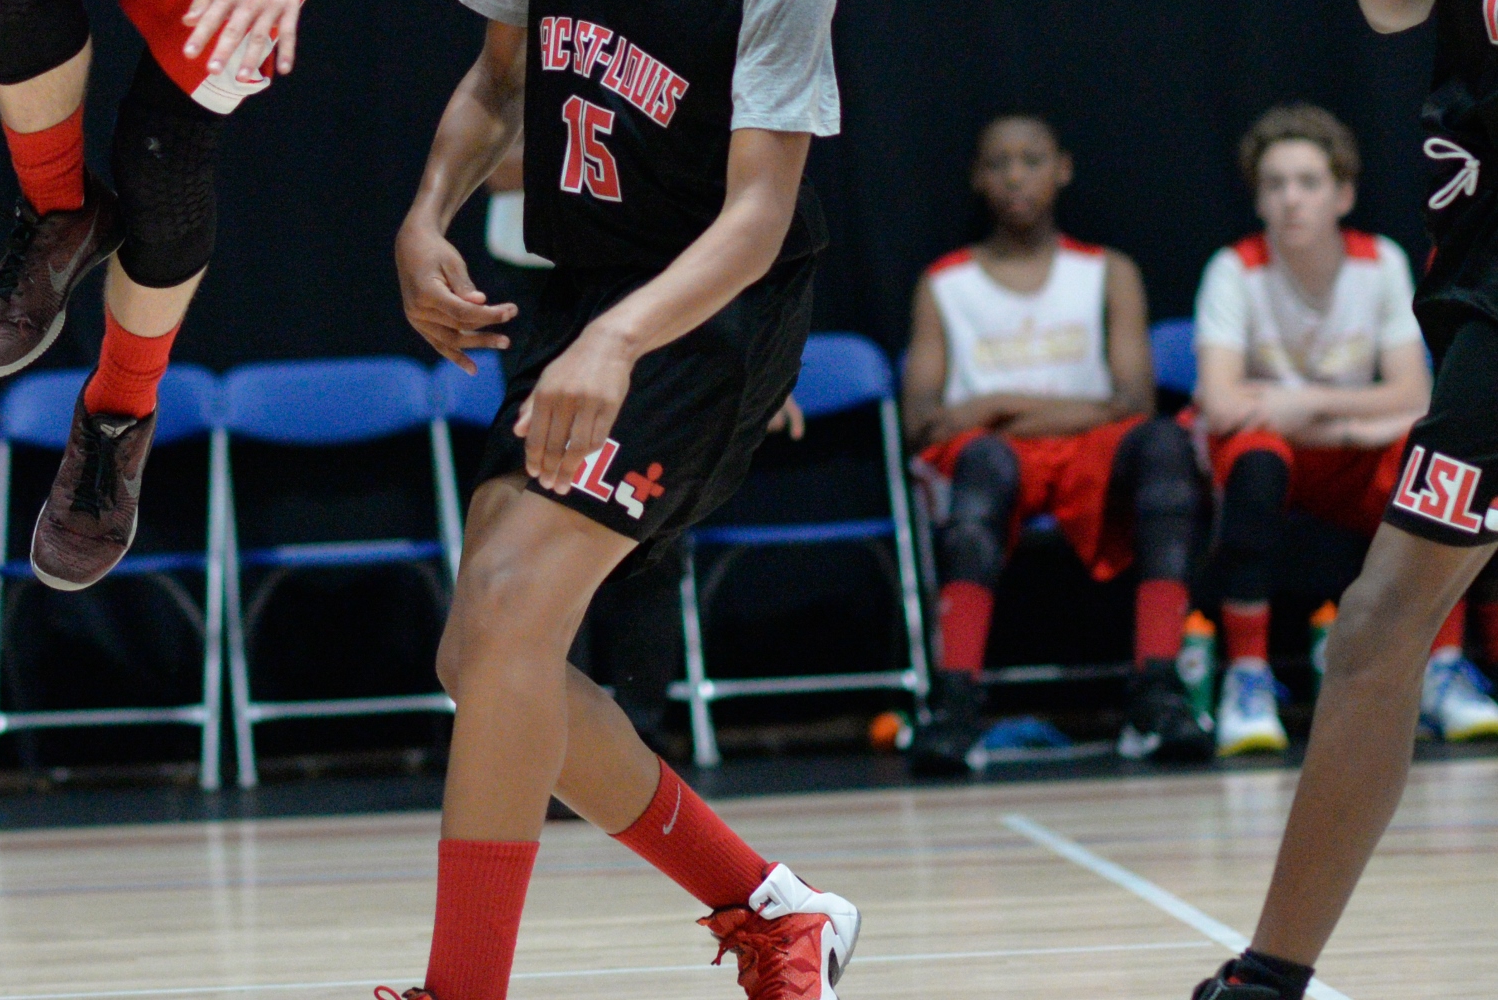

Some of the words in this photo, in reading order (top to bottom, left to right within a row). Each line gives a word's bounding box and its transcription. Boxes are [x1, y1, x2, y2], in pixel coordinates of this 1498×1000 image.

[540, 16, 572, 71] AC
[573, 19, 690, 129] ST-LOUIS
[560, 94, 622, 203] 15
[1392, 444, 1484, 534] LSL
